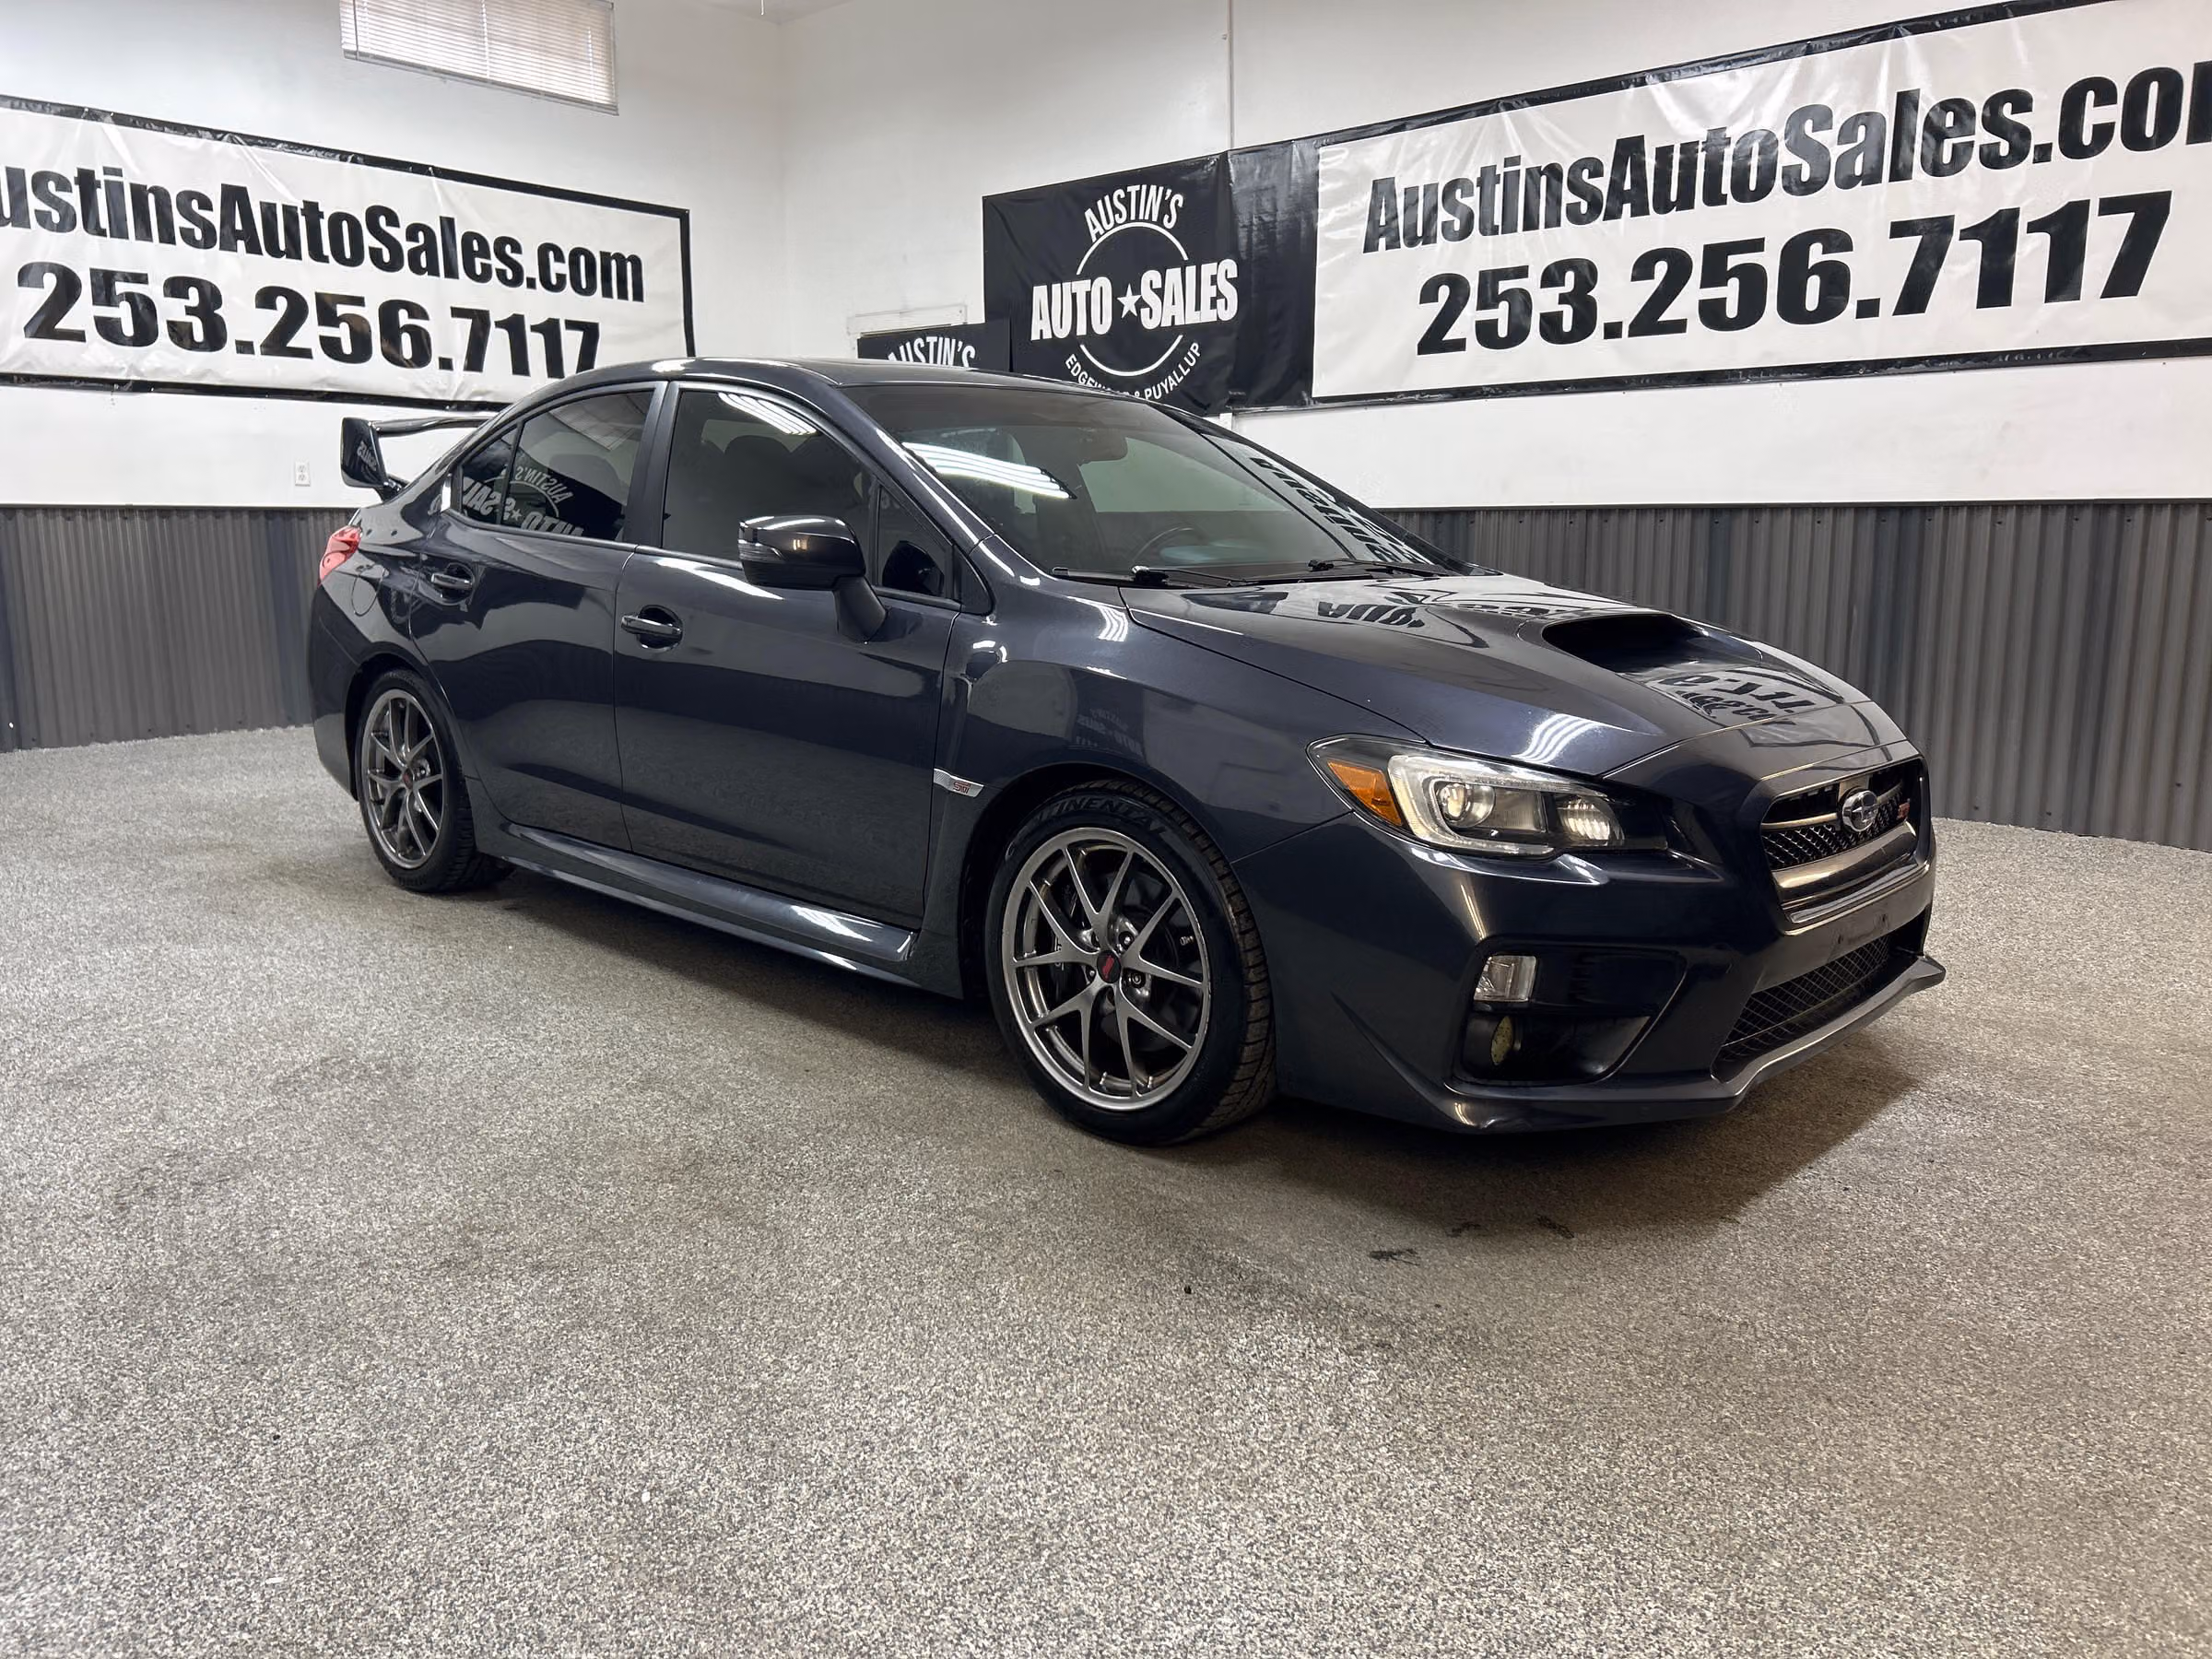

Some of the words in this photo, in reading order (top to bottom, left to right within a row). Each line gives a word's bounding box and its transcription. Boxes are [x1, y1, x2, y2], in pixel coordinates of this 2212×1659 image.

[1084, 184, 1184, 243] AUSTIN'S
[1363, 61, 2212, 253] AustinsAutoSales.co
[0, 166, 643, 302] ustinsAutoSales.com
[1417, 191, 2172, 356] 253.256.7117
[18, 262, 600, 379] 253.256.7117
[1030, 276, 1113, 341] AUTO
[1139, 258, 1239, 330] SALES
[1144, 342, 1202, 400] PUYALLUP
